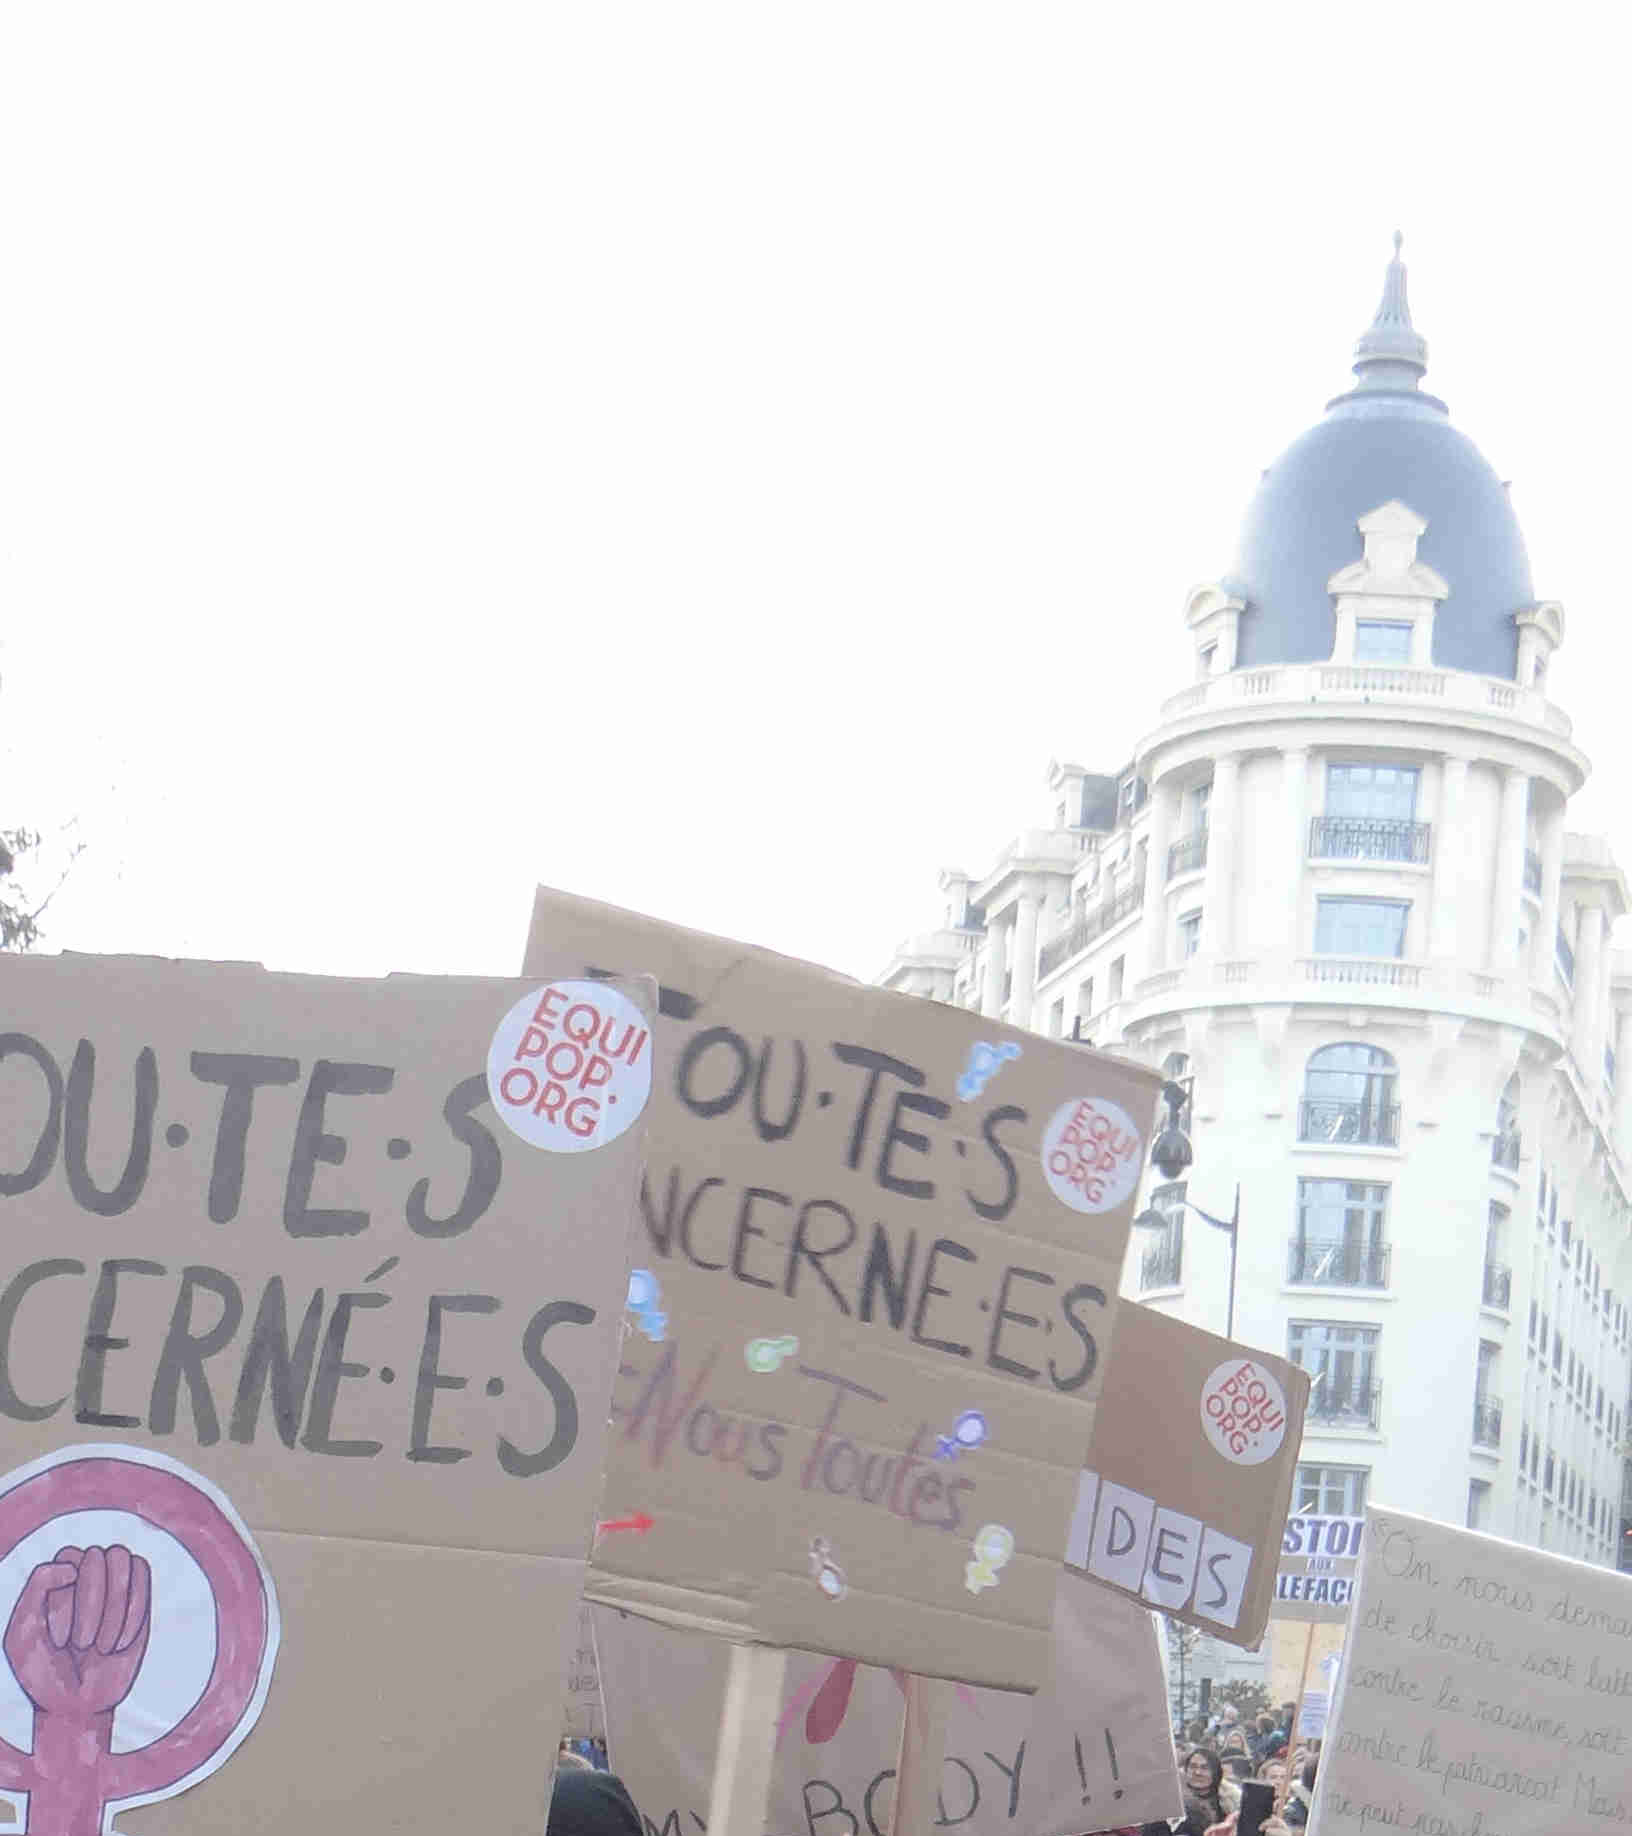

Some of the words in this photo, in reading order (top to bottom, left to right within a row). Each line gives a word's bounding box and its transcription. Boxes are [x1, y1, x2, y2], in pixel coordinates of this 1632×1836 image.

[532, 987, 648, 1066] EQUI
[500, 1067, 601, 1137] ORG
[1072, 1098, 1136, 1163] EQUI
[1049, 1150, 1106, 1204] ORG
[1207, 1395, 1248, 1455] ORG
[1235, 1362, 1284, 1432] EQUI
